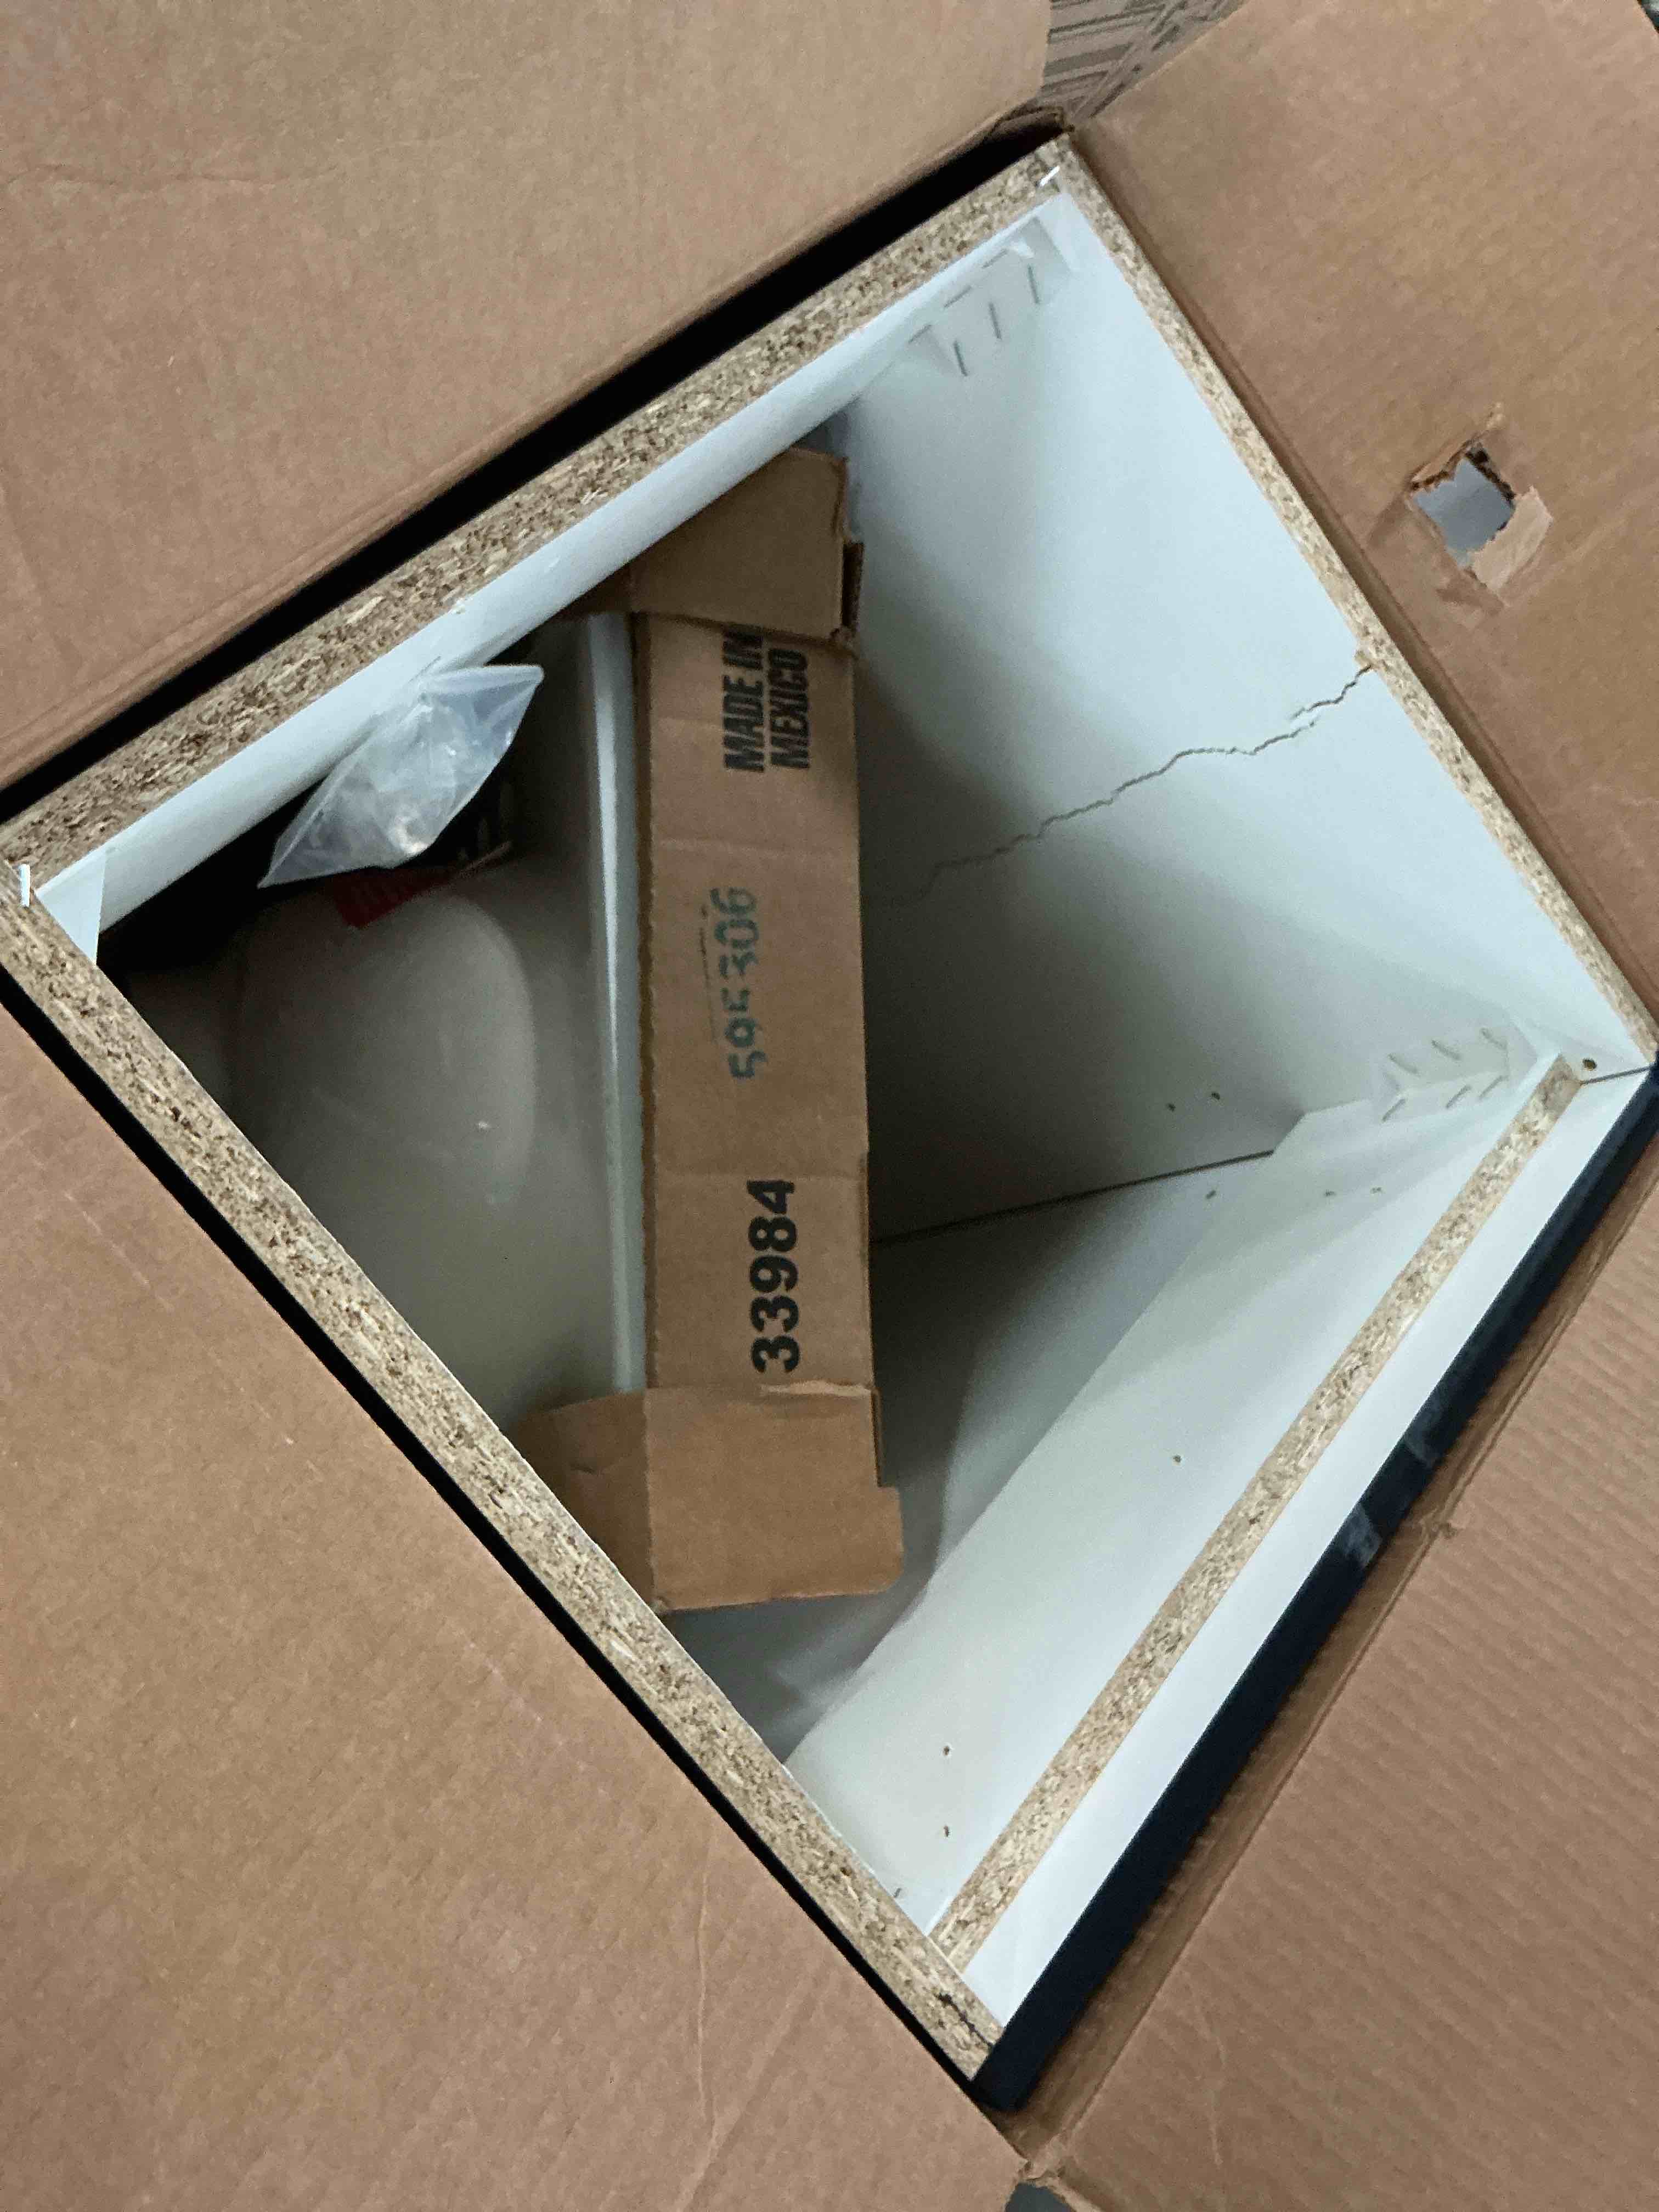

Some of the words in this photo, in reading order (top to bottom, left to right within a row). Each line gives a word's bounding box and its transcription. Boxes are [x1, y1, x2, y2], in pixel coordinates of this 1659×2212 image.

[722, 631, 764, 670] IN
[722, 675, 765, 772] MADE
[768, 648, 810, 769] MEXICO
[746, 1180, 800, 1373] 33984
